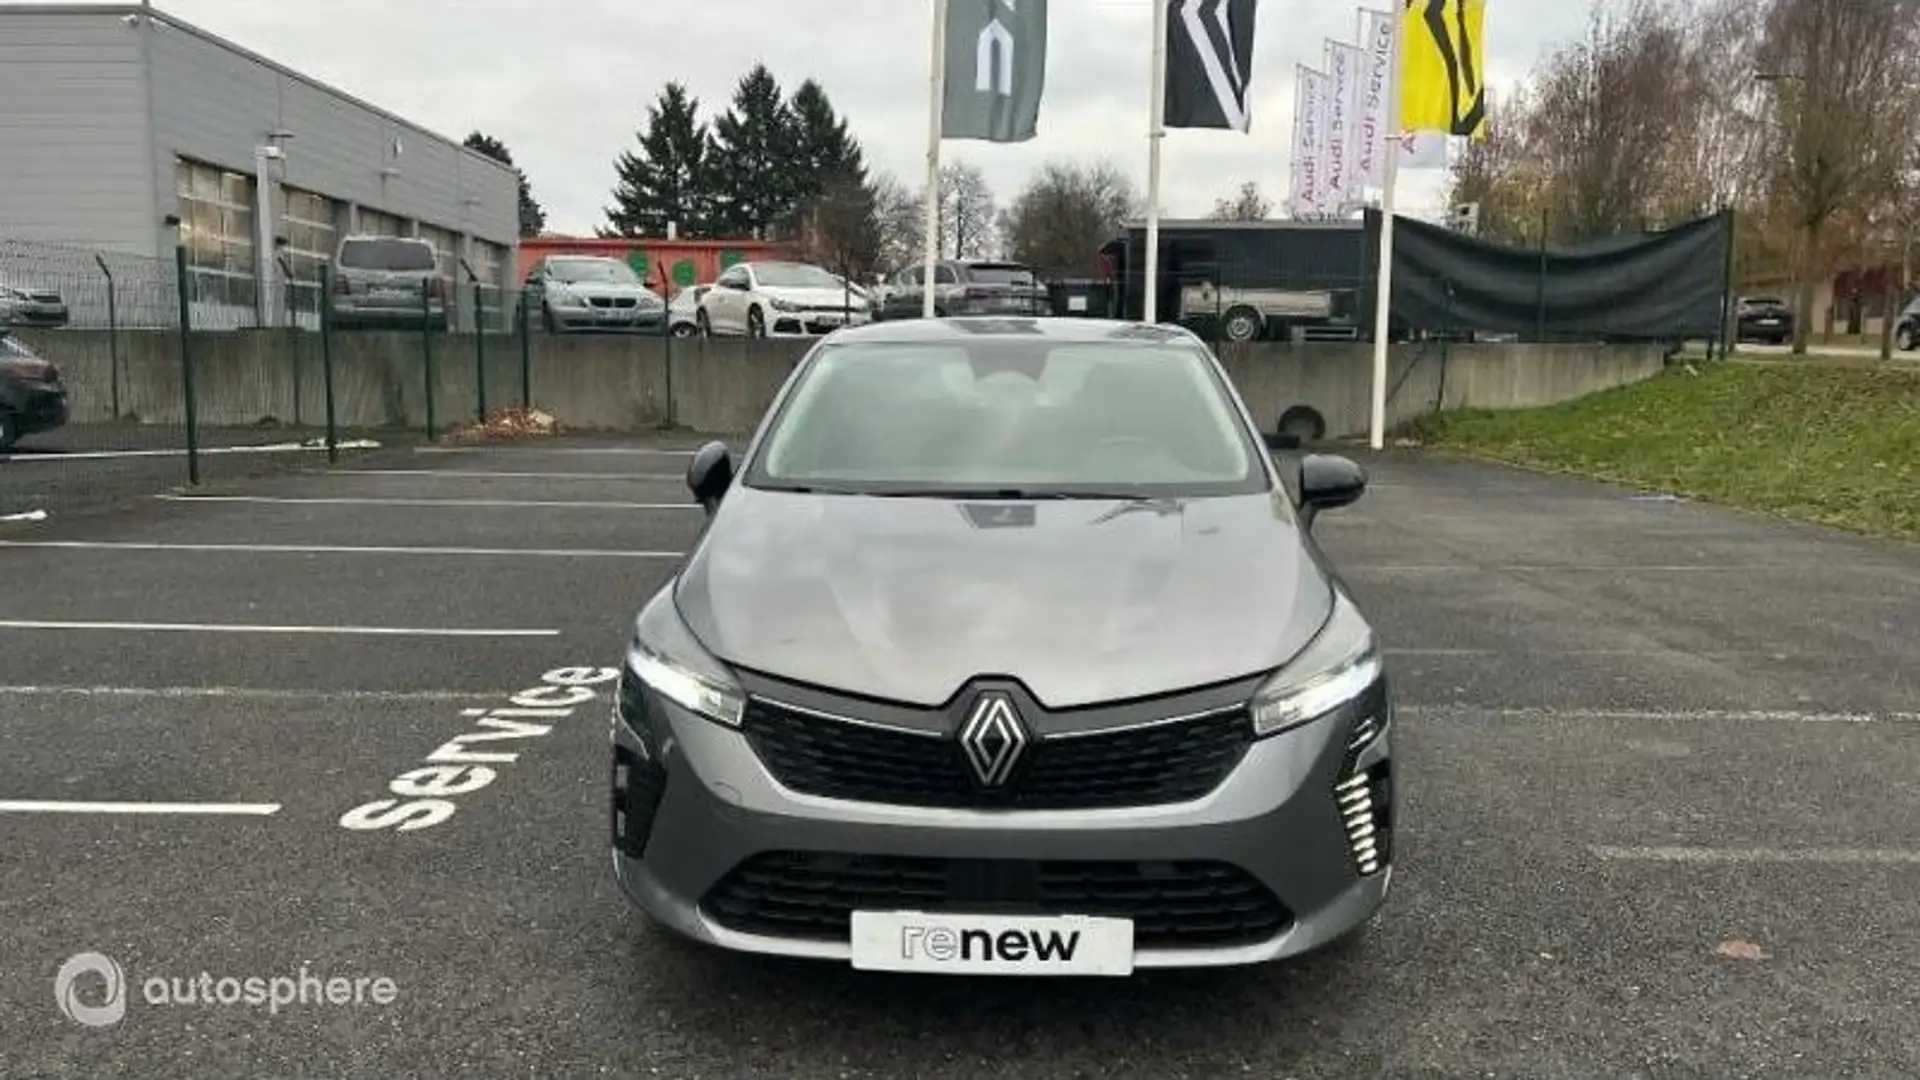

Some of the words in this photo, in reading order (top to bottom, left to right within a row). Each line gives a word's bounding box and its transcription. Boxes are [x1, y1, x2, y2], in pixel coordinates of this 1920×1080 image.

[1365, 22, 1393, 110] Service
[1329, 138, 1343, 189] Audi
[1360, 116, 1376, 171] Audi
[1301, 155, 1315, 203] Audi
[339, 666, 621, 831] service
[901, 926, 1081, 962] renew
